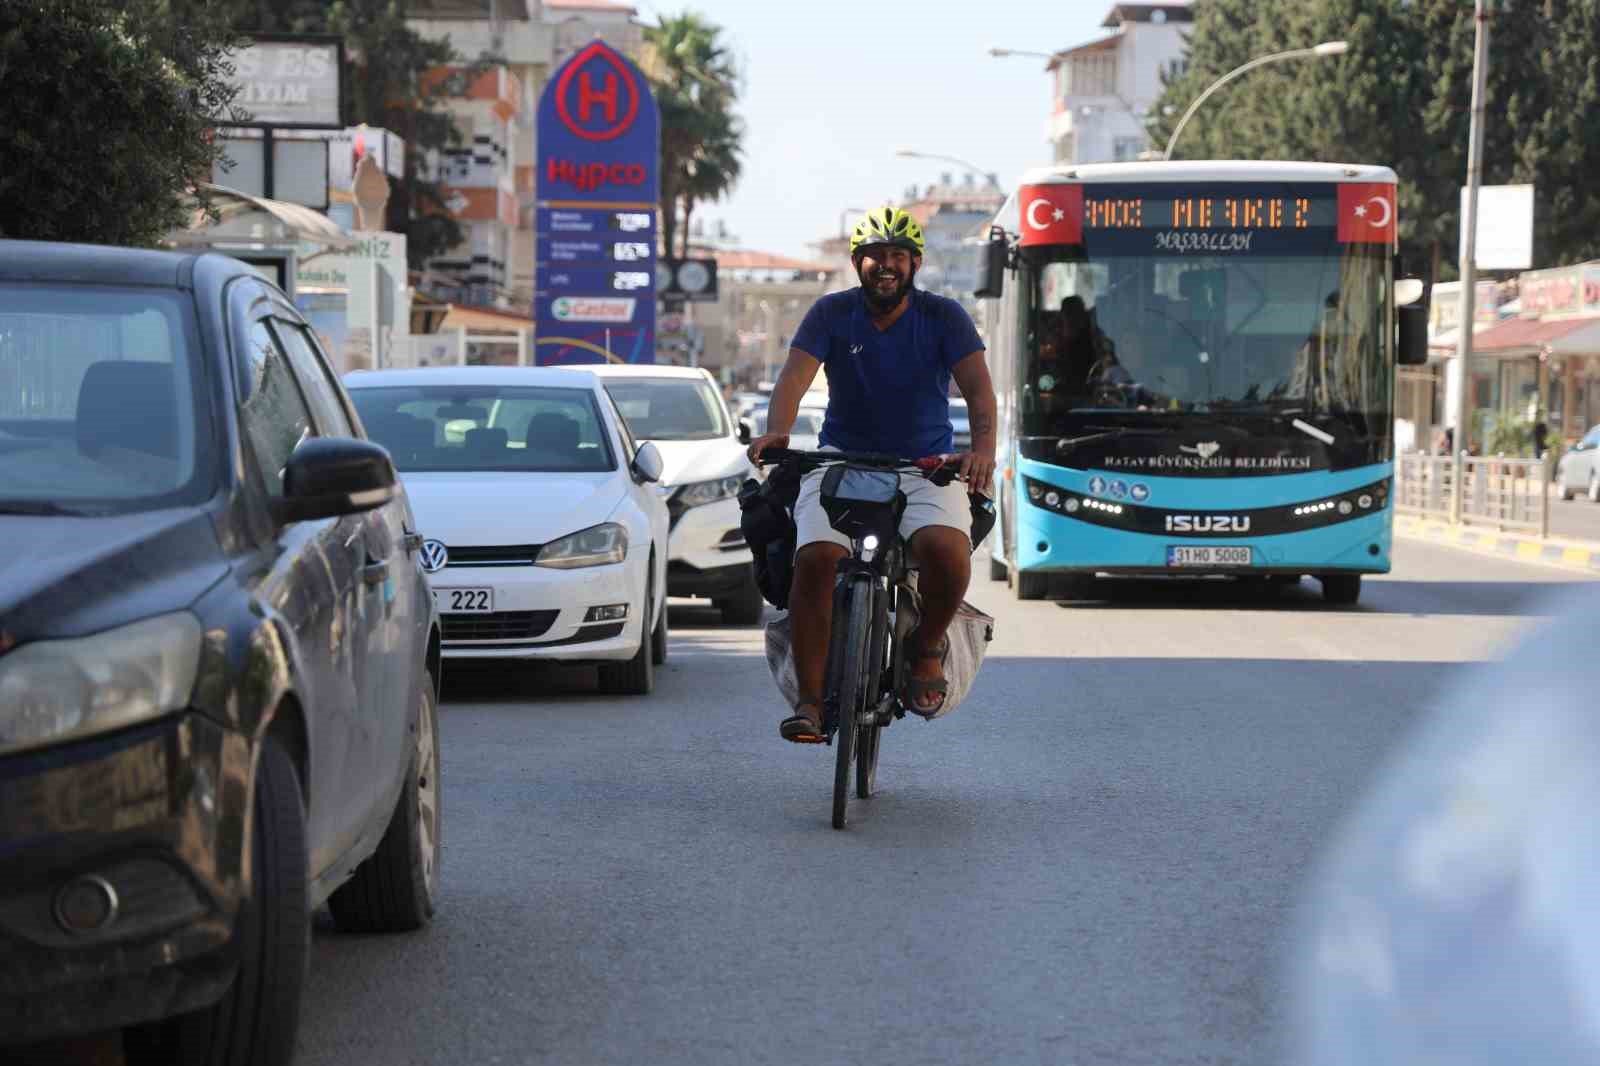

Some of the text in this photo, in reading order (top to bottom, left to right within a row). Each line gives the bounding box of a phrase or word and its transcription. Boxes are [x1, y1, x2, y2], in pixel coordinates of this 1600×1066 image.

[547, 160, 646, 191] Hypco
[1104, 456, 1145, 467] HATAY
[1234, 454, 1311, 468] BELEDİYESİ
[1165, 515, 1250, 532] ISUZU
[1215, 548, 1248, 561] 5008
[451, 590, 489, 611] 222
